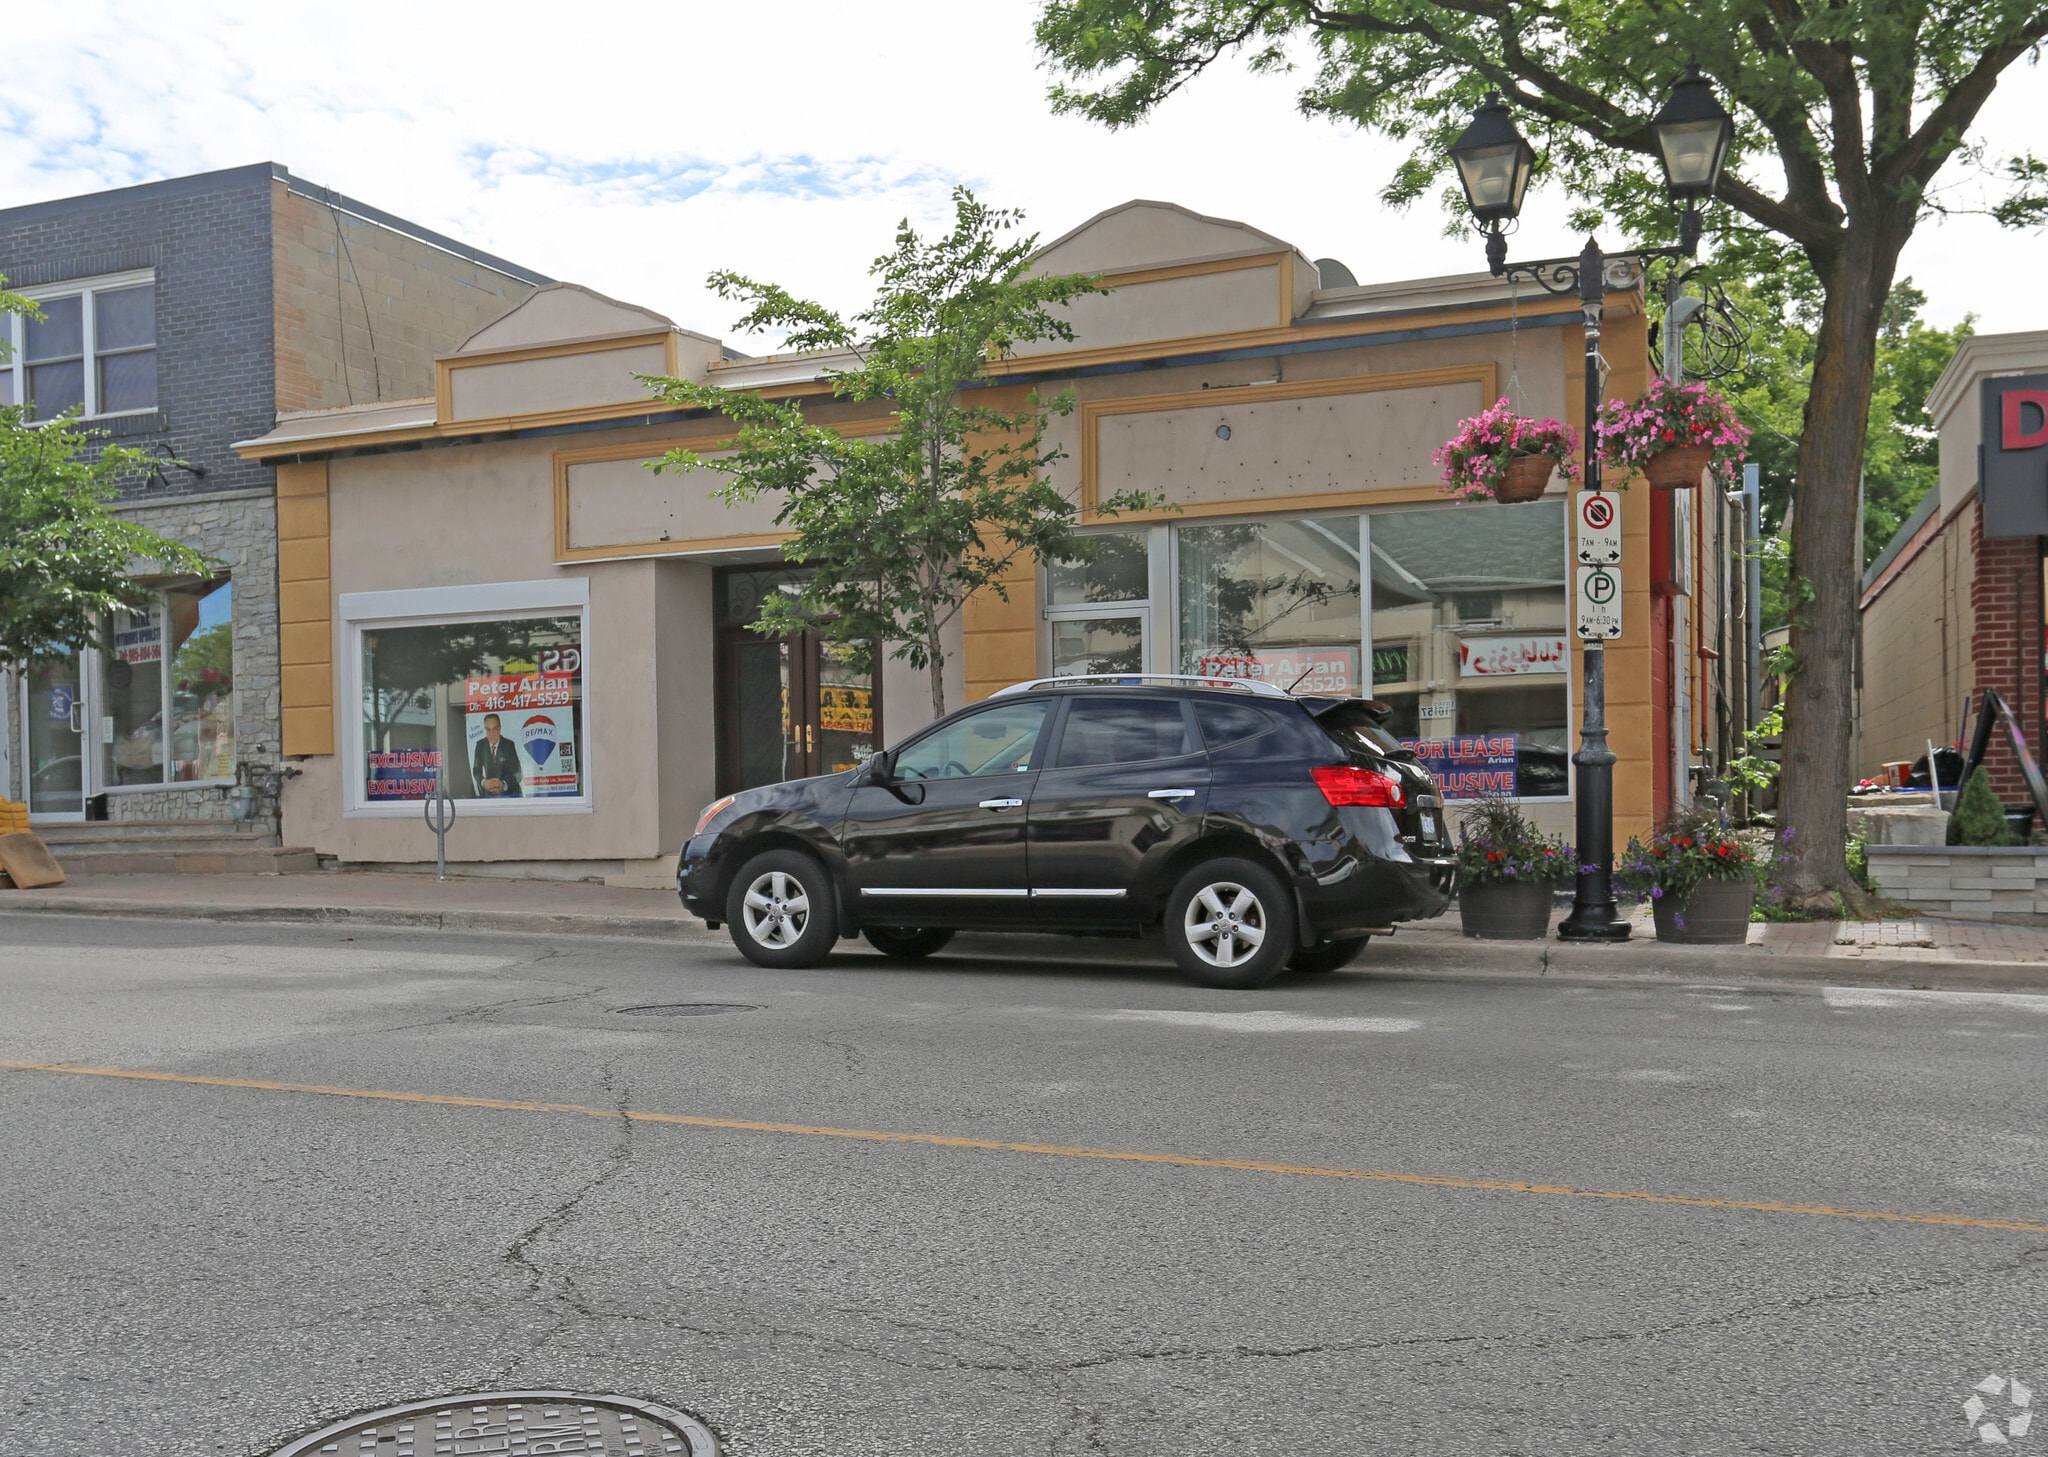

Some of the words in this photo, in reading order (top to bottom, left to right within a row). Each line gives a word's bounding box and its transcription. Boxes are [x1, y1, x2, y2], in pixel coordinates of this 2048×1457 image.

[1581, 538, 1594, 547] 7AM
[1604, 538, 1617, 547] 9AM
[1595, 577, 1609, 599] P
[1205, 661, 1273, 678] Peter
[1276, 656, 1346, 677] Arian
[468, 681, 518, 696] Peter
[518, 675, 568, 692] Arian
[469, 701, 482, 712] Dir:
[485, 691, 569, 710] 416-417-5529
[525, 727, 553, 738] RE/MAX
[1448, 738, 1515, 758] LEASE
[369, 751, 442, 769] EXCLUSIVE
[1487, 756, 1514, 764] Arian
[1432, 771, 1514, 791] LUSIVE
